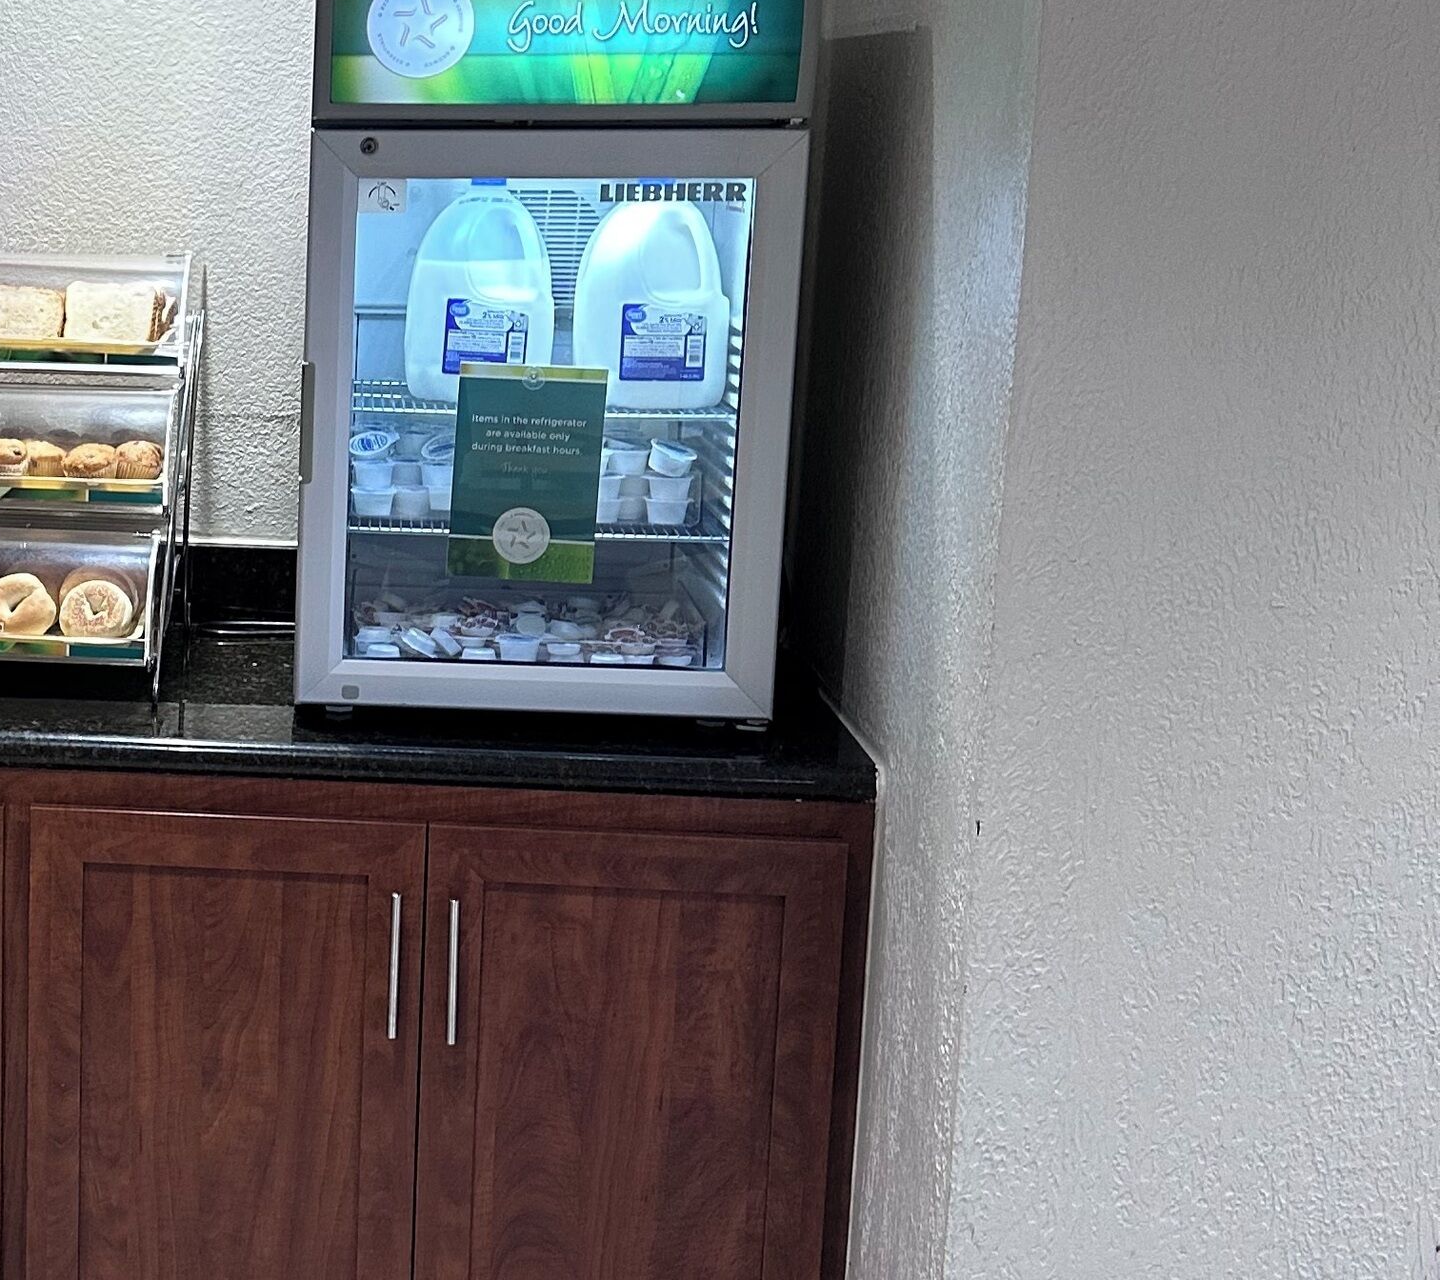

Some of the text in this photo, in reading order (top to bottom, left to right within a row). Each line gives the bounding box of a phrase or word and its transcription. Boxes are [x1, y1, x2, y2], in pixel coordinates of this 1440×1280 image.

[507, 0, 583, 53] Good
[599, 182, 747, 202] LIEBHERR
[501, 415, 510, 423] in
[512, 415, 529, 424] the
[531, 416, 587, 428] refrigerator
[485, 429, 571, 442] are available only
[471, 441, 503, 453] during
[505, 443, 550, 454] breakfast
